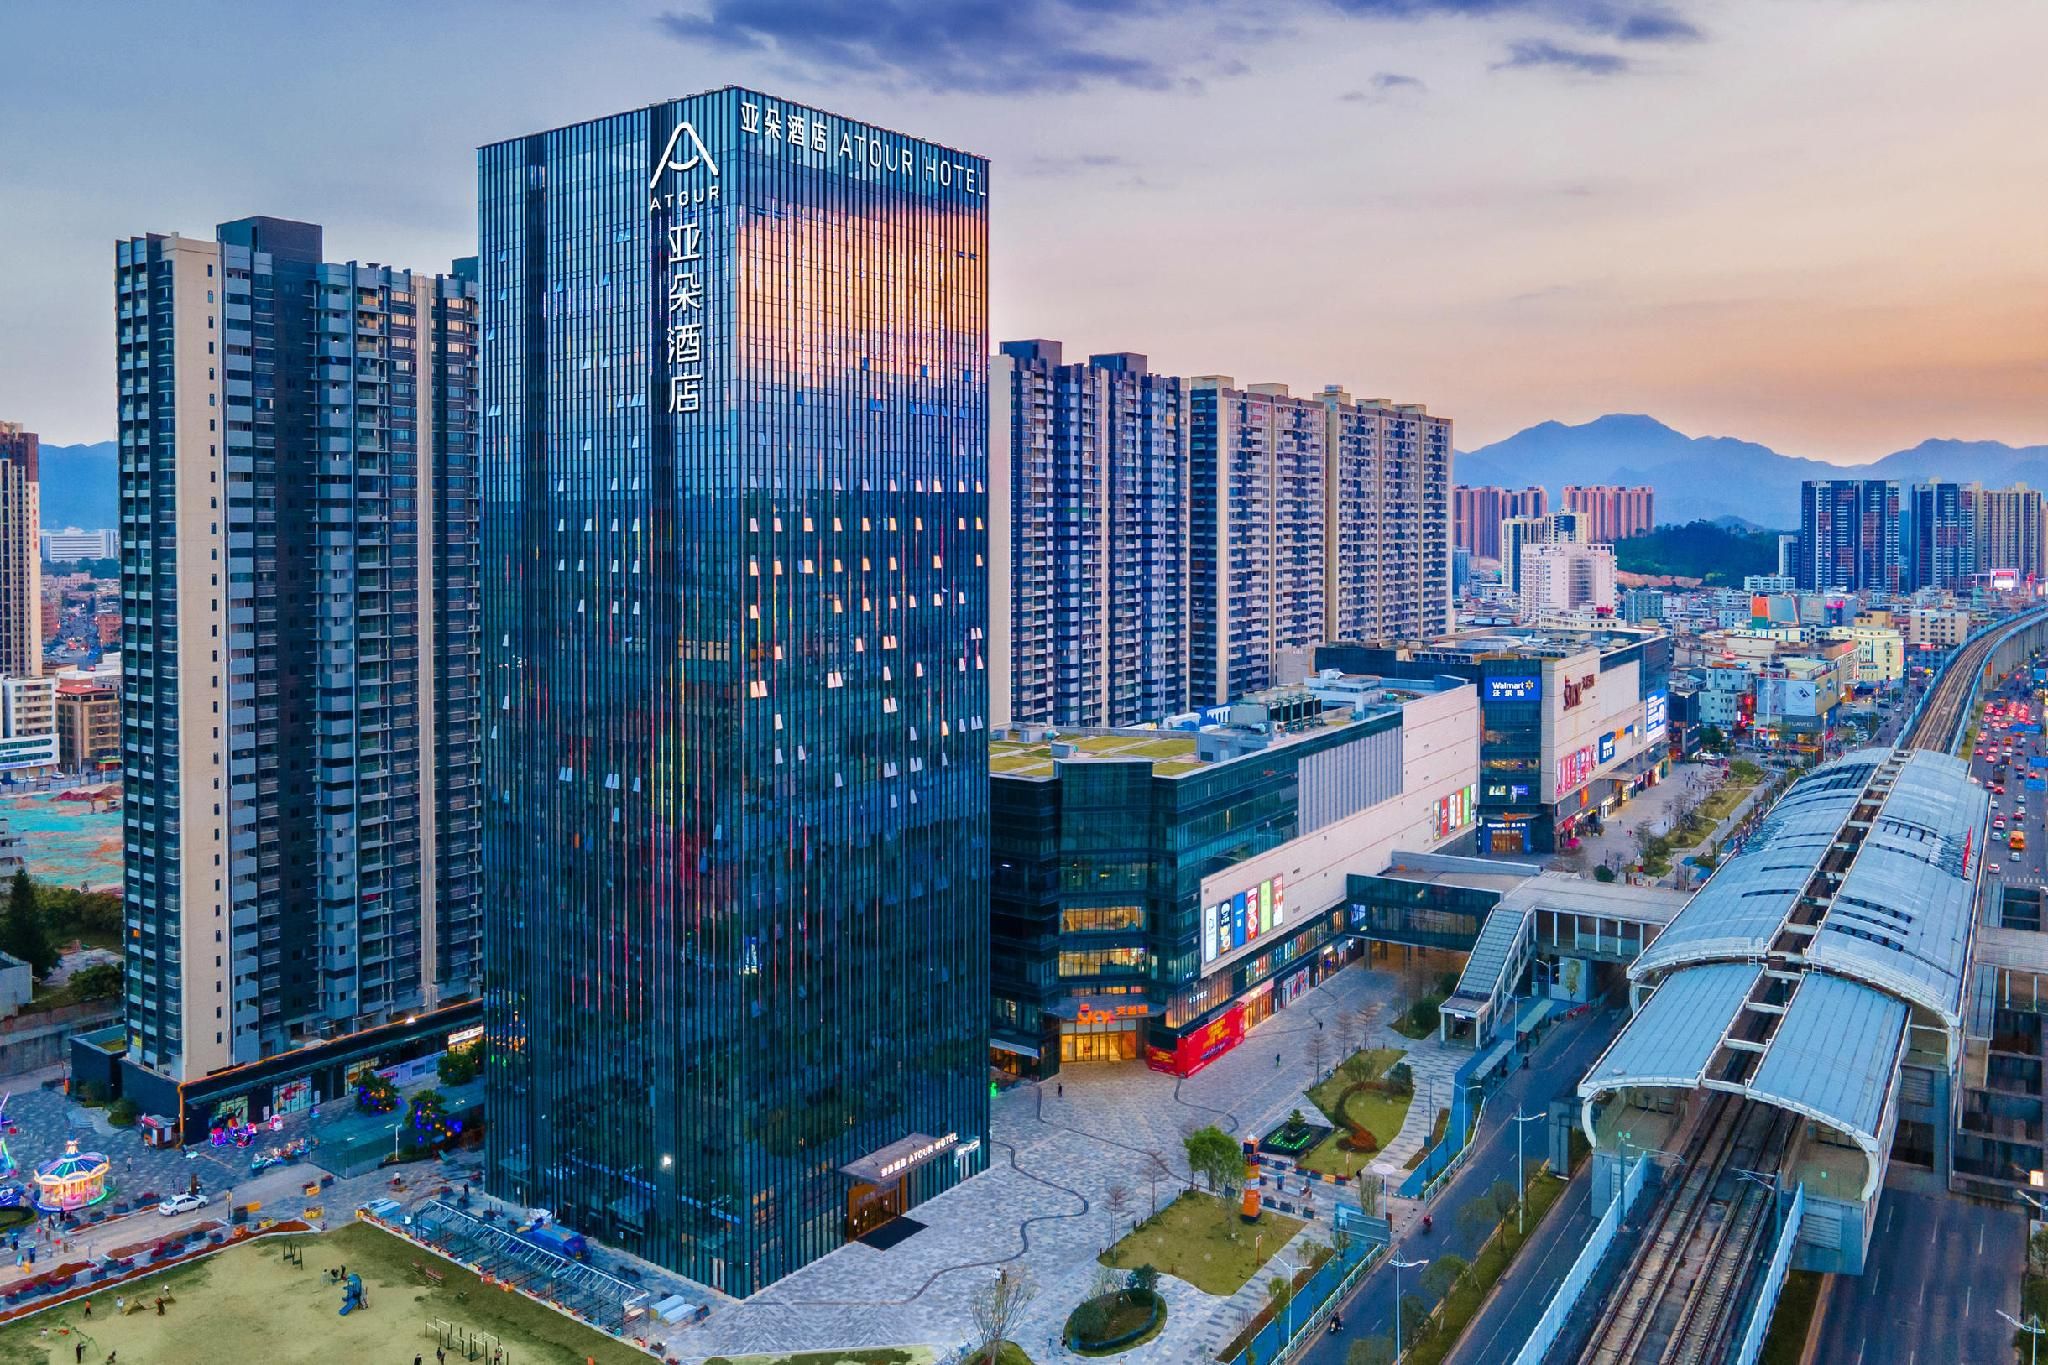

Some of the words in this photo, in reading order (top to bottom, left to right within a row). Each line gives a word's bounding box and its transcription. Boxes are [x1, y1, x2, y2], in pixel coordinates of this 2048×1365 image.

[740, 101, 827, 153] 亚朵酒店
[839, 133, 913, 176] ATOUR
[925, 157, 987, 196] HOTEL
[650, 185, 719, 211] ATOUR
[667, 222, 703, 414] 亚朵酒店
[1492, 682, 1524, 690] Walmart
[908, 1144, 934, 1164] ATOUR
[935, 1132, 959, 1151] HOTEL
